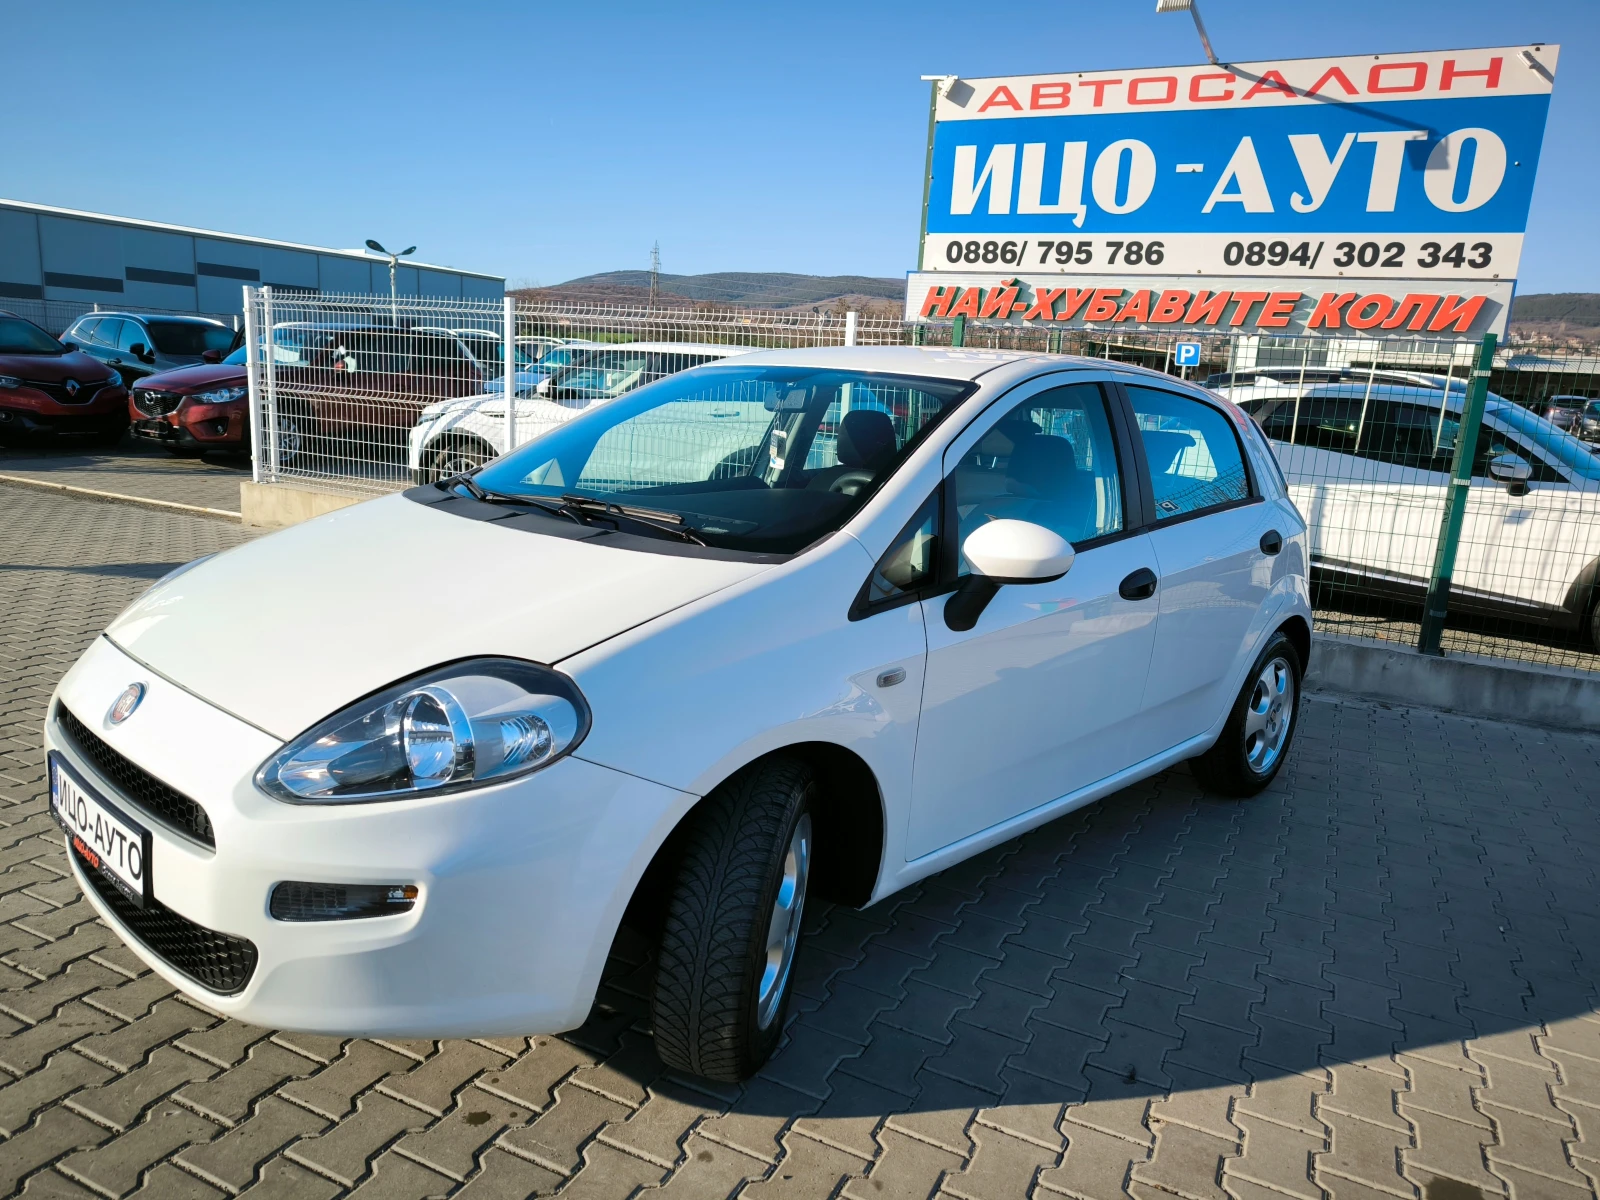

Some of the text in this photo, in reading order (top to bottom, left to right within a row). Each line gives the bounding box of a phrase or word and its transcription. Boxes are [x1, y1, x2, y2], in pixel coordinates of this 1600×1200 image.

[978, 56, 1504, 113] АВТОСАЛОН
[946, 240, 1493, 270] 0886/ 795 786 0894/ 302 343
[919, 278, 1488, 333] НАЙ-ХУБАВИТЕ КОЛИ
[1180, 345, 1196, 363] P
[59, 773, 143, 881] ИЦО-АУТО
